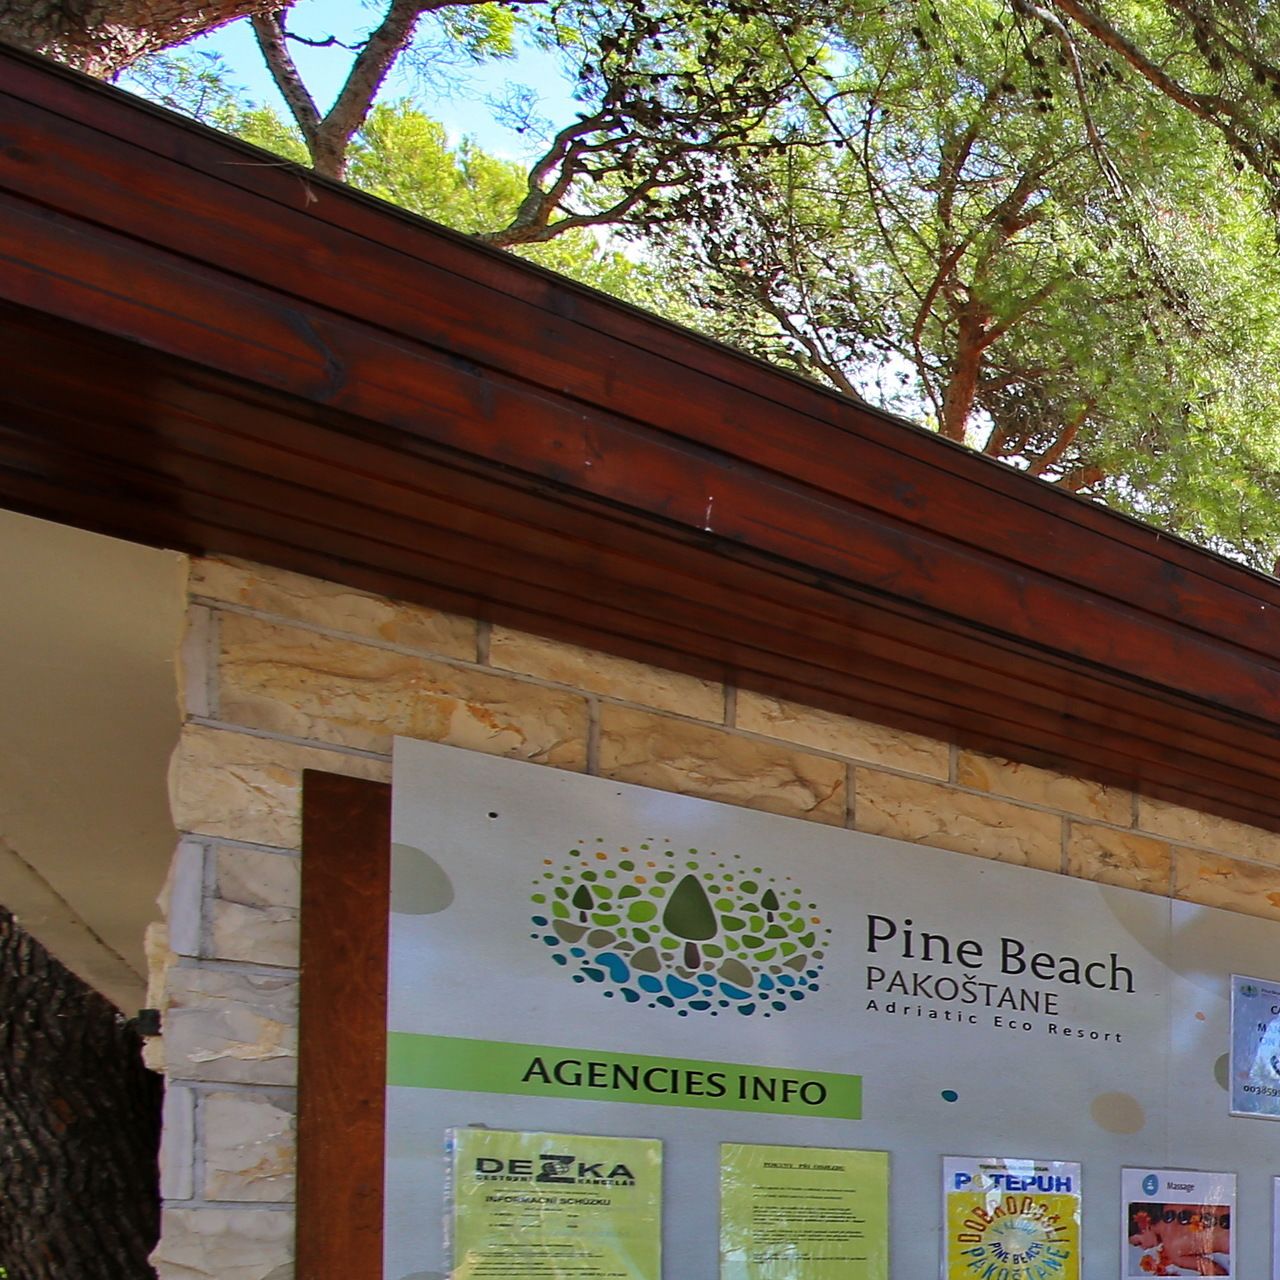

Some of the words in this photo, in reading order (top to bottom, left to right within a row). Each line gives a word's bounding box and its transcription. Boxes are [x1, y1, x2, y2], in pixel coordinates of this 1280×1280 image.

[866, 914, 984, 969] Pine
[1000, 937, 1136, 994] Beach
[866, 966, 1059, 1016] PAKOŠTANE
[866, 999, 978, 1025] Adriatic
[994, 1016, 1033, 1032] Eco
[1048, 1023, 1123, 1043] Resort
[521, 1056, 727, 1098] AGENCIES
[738, 1075, 827, 1106] INFO
[954, 1173, 1071, 1193] POTEPUH
[1167, 1182, 1195, 1193] Massage
[988, 1242, 1009, 1264] PINE
[1012, 1242, 1045, 1265] BEACH
